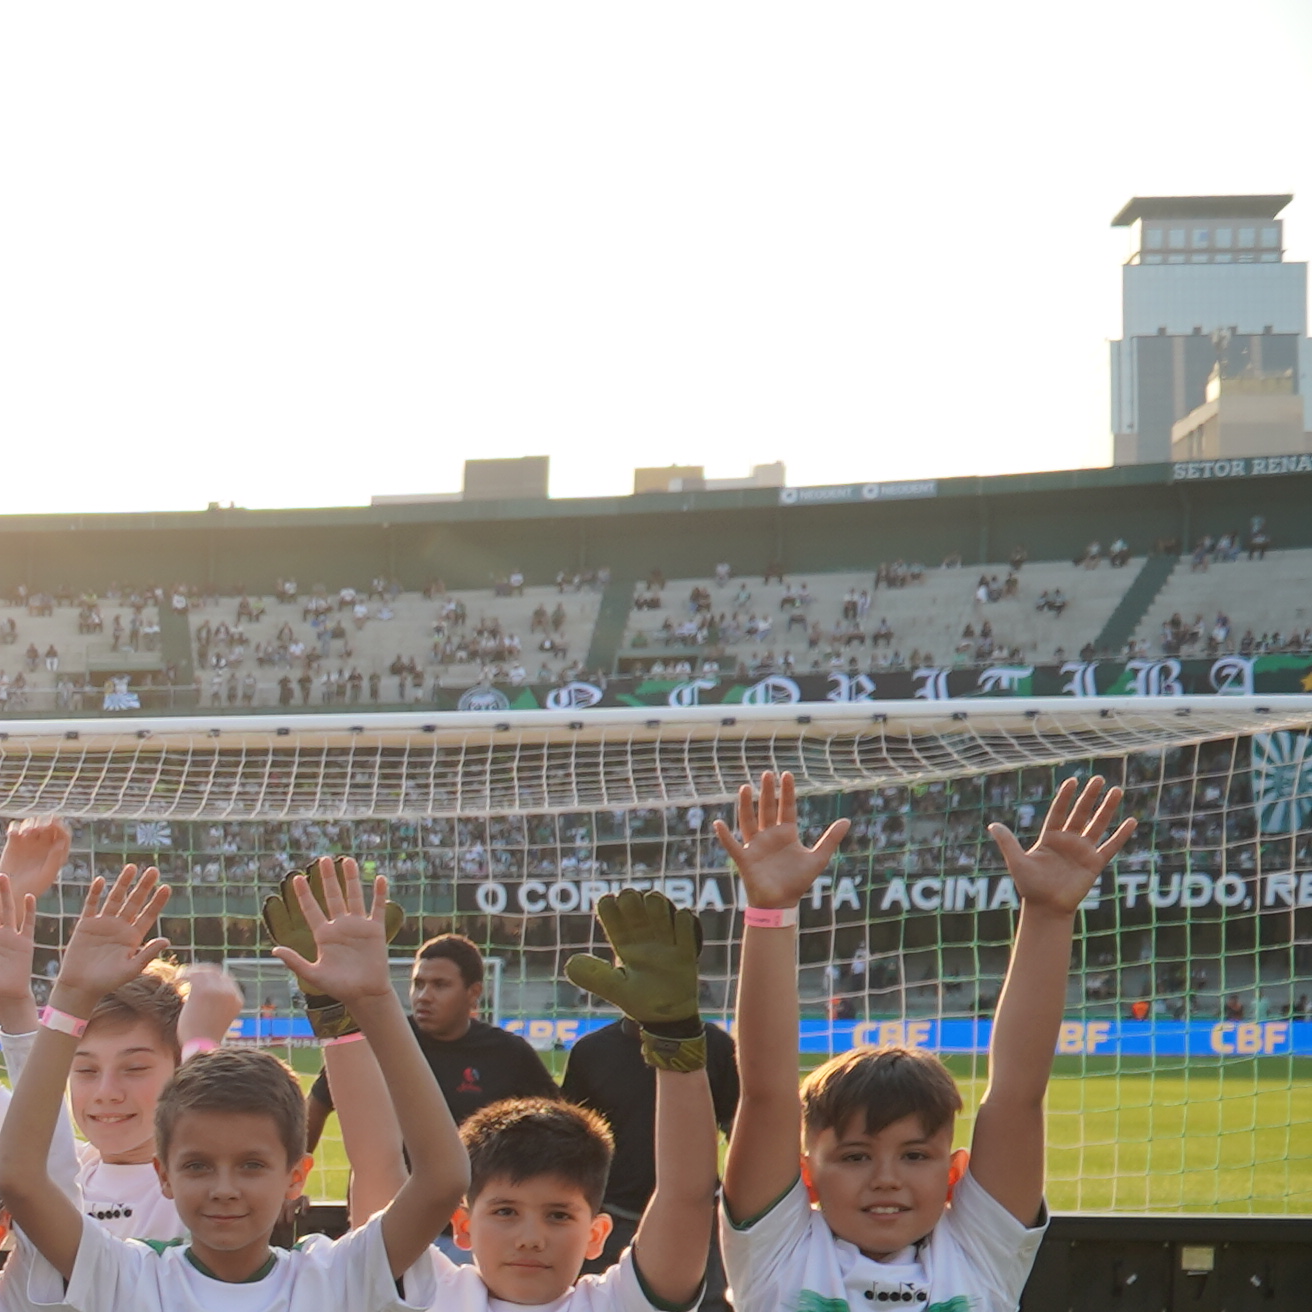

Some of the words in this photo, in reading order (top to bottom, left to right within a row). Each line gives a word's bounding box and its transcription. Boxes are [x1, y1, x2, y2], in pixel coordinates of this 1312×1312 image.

[1174, 460, 1246, 480] SETOR
[476, 881, 507, 914] O
[517, 878, 725, 913] CORBA
[881, 875, 1019, 911] ACIMA
[1115, 871, 1252, 910] TUDO,
[852, 1022, 931, 1050] CBF
[1059, 1022, 1111, 1053] BF
[1211, 1022, 1288, 1054] CBF
[864, 1281, 927, 1303] diadora
